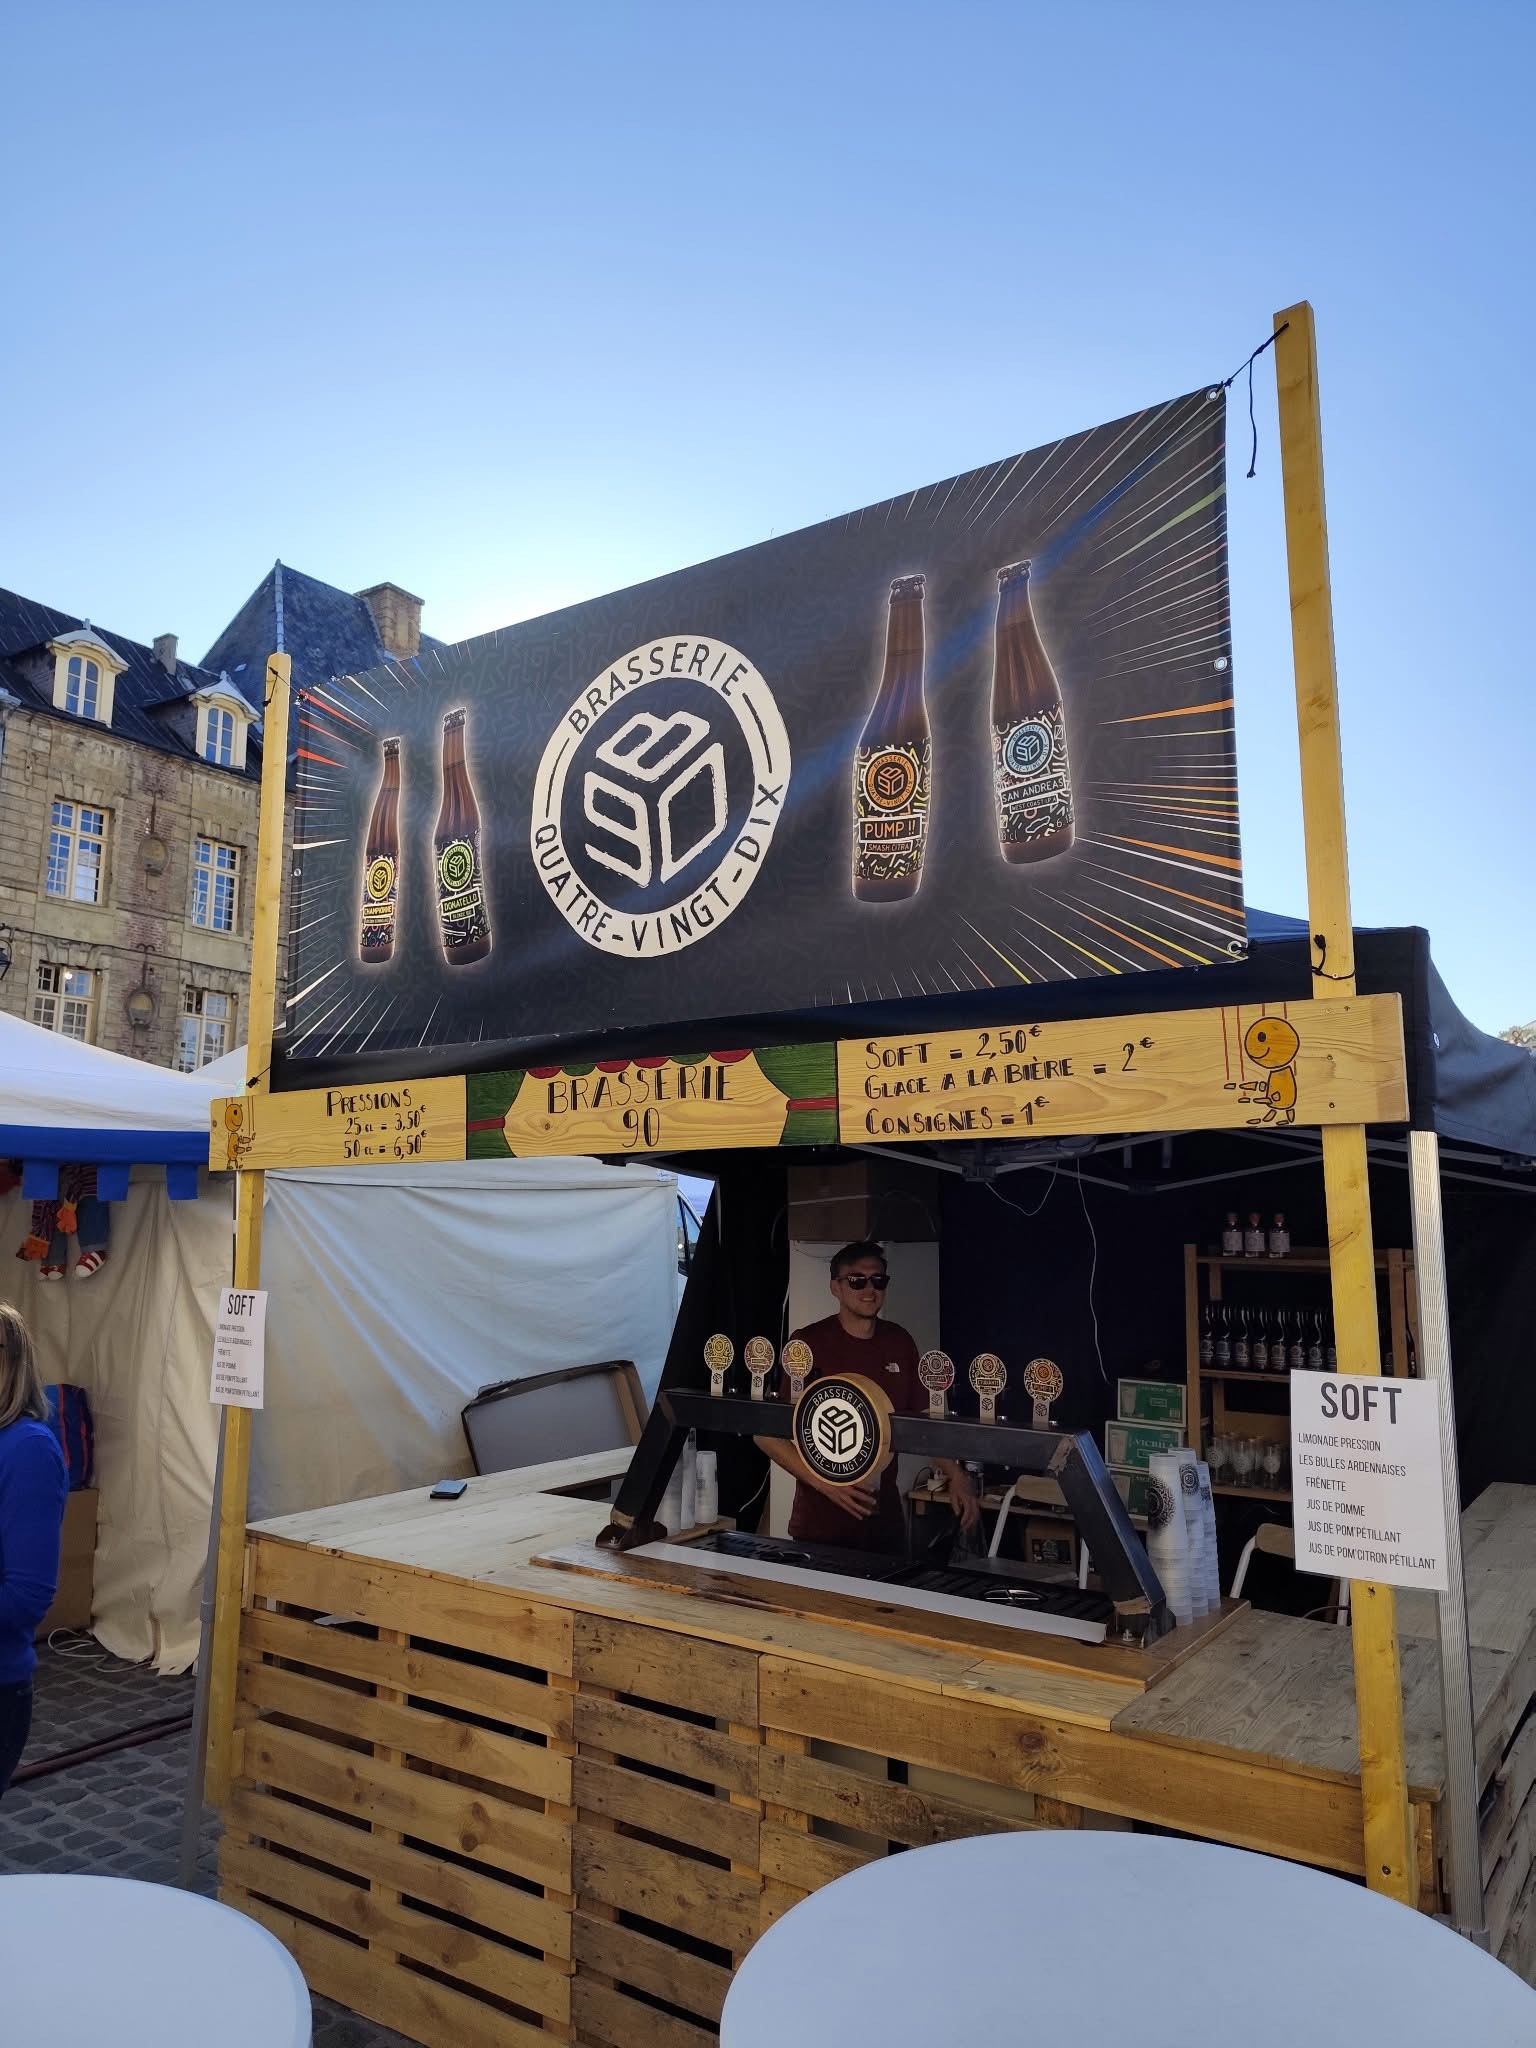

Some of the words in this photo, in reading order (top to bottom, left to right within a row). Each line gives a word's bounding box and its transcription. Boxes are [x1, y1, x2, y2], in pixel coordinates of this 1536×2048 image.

[568, 643, 748, 735] BRASSERIE
[874, 756, 908, 769] BRASSERIE
[1002, 791, 1020, 804] SAN
[1022, 778, 1064, 798] ANDREAS
[1011, 803, 1025, 811] WEST
[1027, 799, 1044, 808] COAST
[865, 821, 905, 838] PUMP
[908, 819, 916, 836] !!
[868, 843, 890, 852] SMASH
[891, 843, 910, 852] CITRA
[535, 784, 783, 951] QUATRE-VINGT-DIX
[444, 893, 478, 912] DONATELLO
[865, 1042, 932, 1070] SOFT
[547, 1065, 735, 1114] BRASSERIE
[864, 1075, 931, 1100] GLACE
[941, 1073, 956, 1091] A
[967, 1065, 998, 1088] LA
[1004, 1056, 1075, 1084] BIÈRE
[326, 1088, 413, 1117] PRESSIONS
[622, 1106, 661, 1148] 90
[865, 1106, 993, 1135] CONSIGNES
[227, 1294, 256, 1317] SOFT
[812, 1388, 864, 1412] BRASSERIE
[1320, 1382, 1402, 1425] SOFT
[804, 1428, 872, 1473] QUATRE-VINGT-DIX
[1298, 1432, 1339, 1448] LIMONADE
[1340, 1437, 1381, 1452] PRESSION
[1299, 1453, 1314, 1466] LES
[1315, 1455, 1346, 1470] BULLES
[1347, 1460, 1407, 1477] ARDENNAISES
[1306, 1498, 1321, 1510] JUS
[1322, 1500, 1333, 1512] DE
[1335, 1502, 1366, 1517] POMME
[1308, 1520, 1322, 1533] JUS
[1323, 1522, 1334, 1534] DE
[1309, 1542, 1323, 1555] JUS
[1324, 1544, 1335, 1557] DE
[1389, 1552, 1437, 1570] PÉTILLANT
